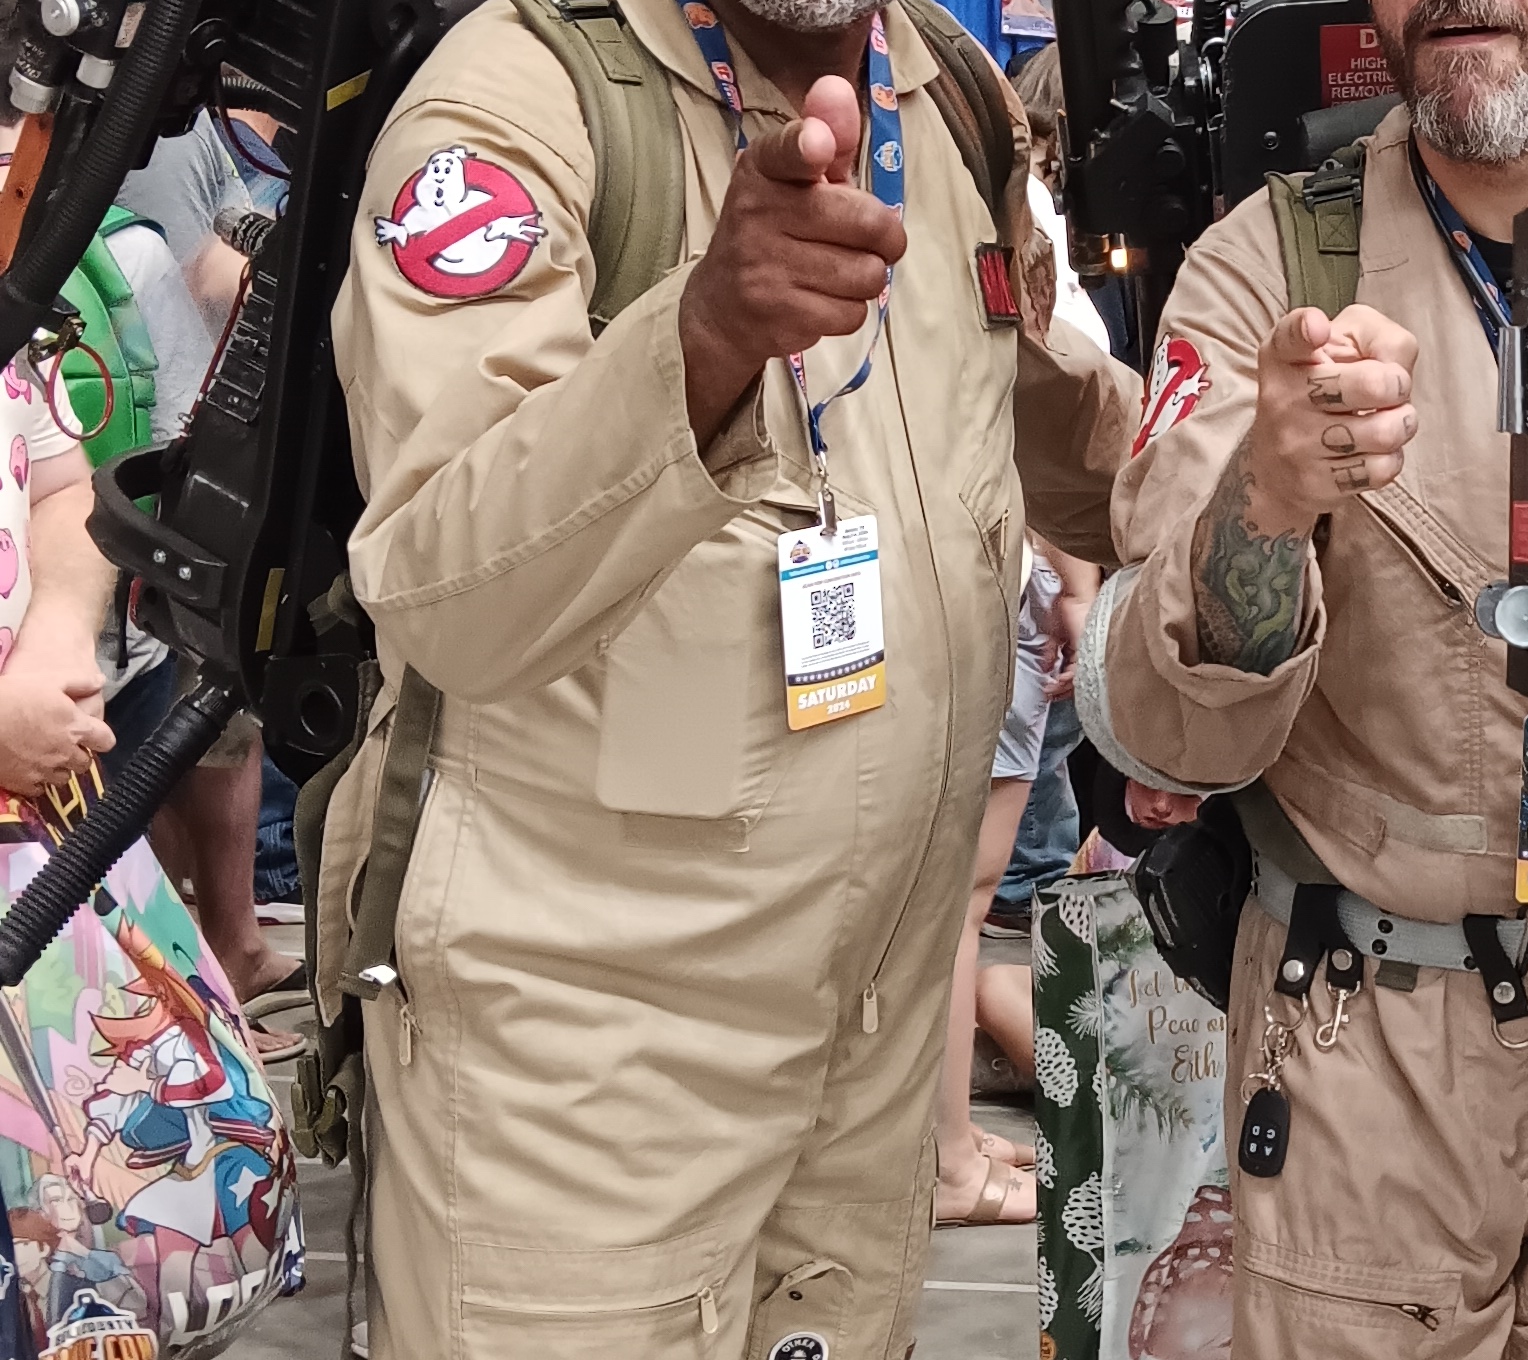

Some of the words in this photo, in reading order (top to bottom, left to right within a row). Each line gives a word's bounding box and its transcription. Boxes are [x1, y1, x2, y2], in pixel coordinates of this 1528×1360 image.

[1350, 57, 1387, 69] HIGH
[1328, 71, 1394, 85] ELECTRIC
[1331, 85, 1395, 99] REMOVE
[798, 674, 877, 709] SATURDAY
[827, 700, 851, 715] 2024
